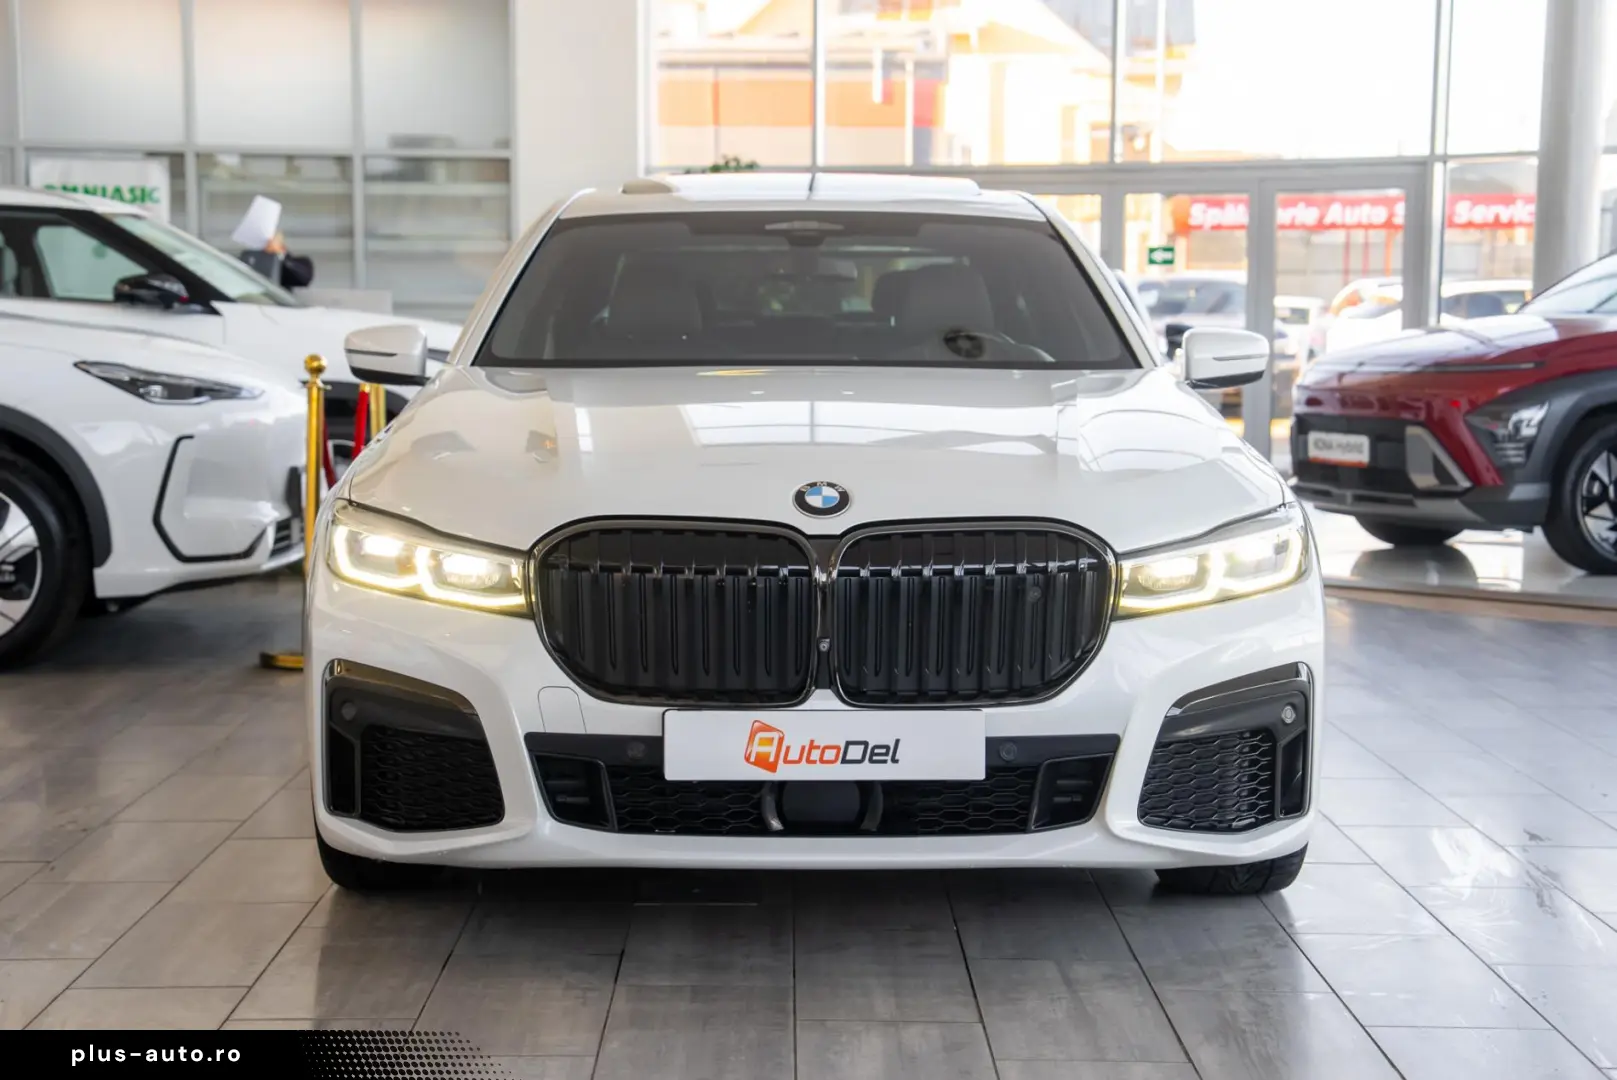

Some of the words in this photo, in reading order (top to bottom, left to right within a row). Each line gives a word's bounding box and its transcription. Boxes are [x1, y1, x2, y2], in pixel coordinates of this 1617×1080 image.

[1322, 201, 1388, 225] Auto
[1453, 200, 1536, 225] Servic
[799, 481, 846, 492] BMW
[747, 728, 901, 767] AutoDel
